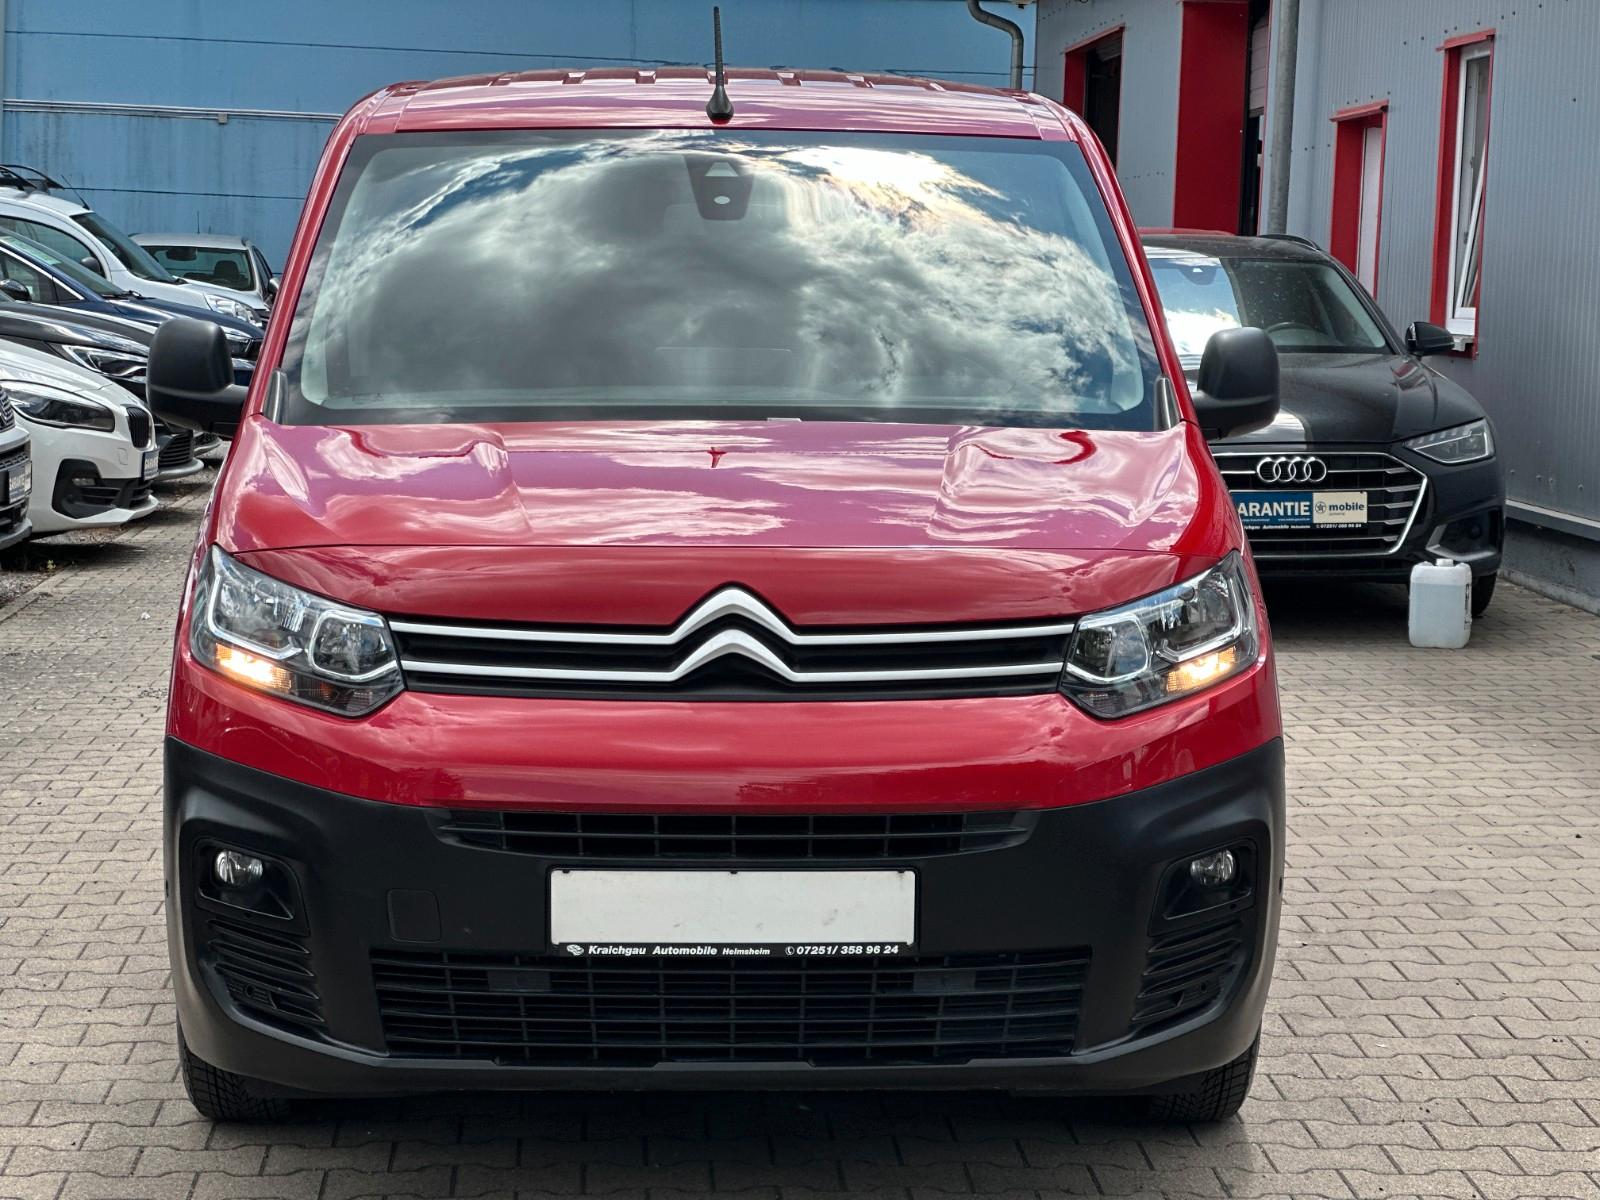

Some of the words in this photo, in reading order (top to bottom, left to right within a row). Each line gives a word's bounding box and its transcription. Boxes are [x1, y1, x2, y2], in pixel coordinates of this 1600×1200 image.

[1238, 502, 1310, 517] ARANTIE
[1328, 502, 1365, 512] mobile
[588, 945, 647, 956] Kraichgau
[652, 945, 718, 956] Automobile
[796, 945, 838, 955] 07251/
[840, 944, 863, 955] 358
[866, 944, 881, 954] 96
[883, 944, 899, 954] 24
